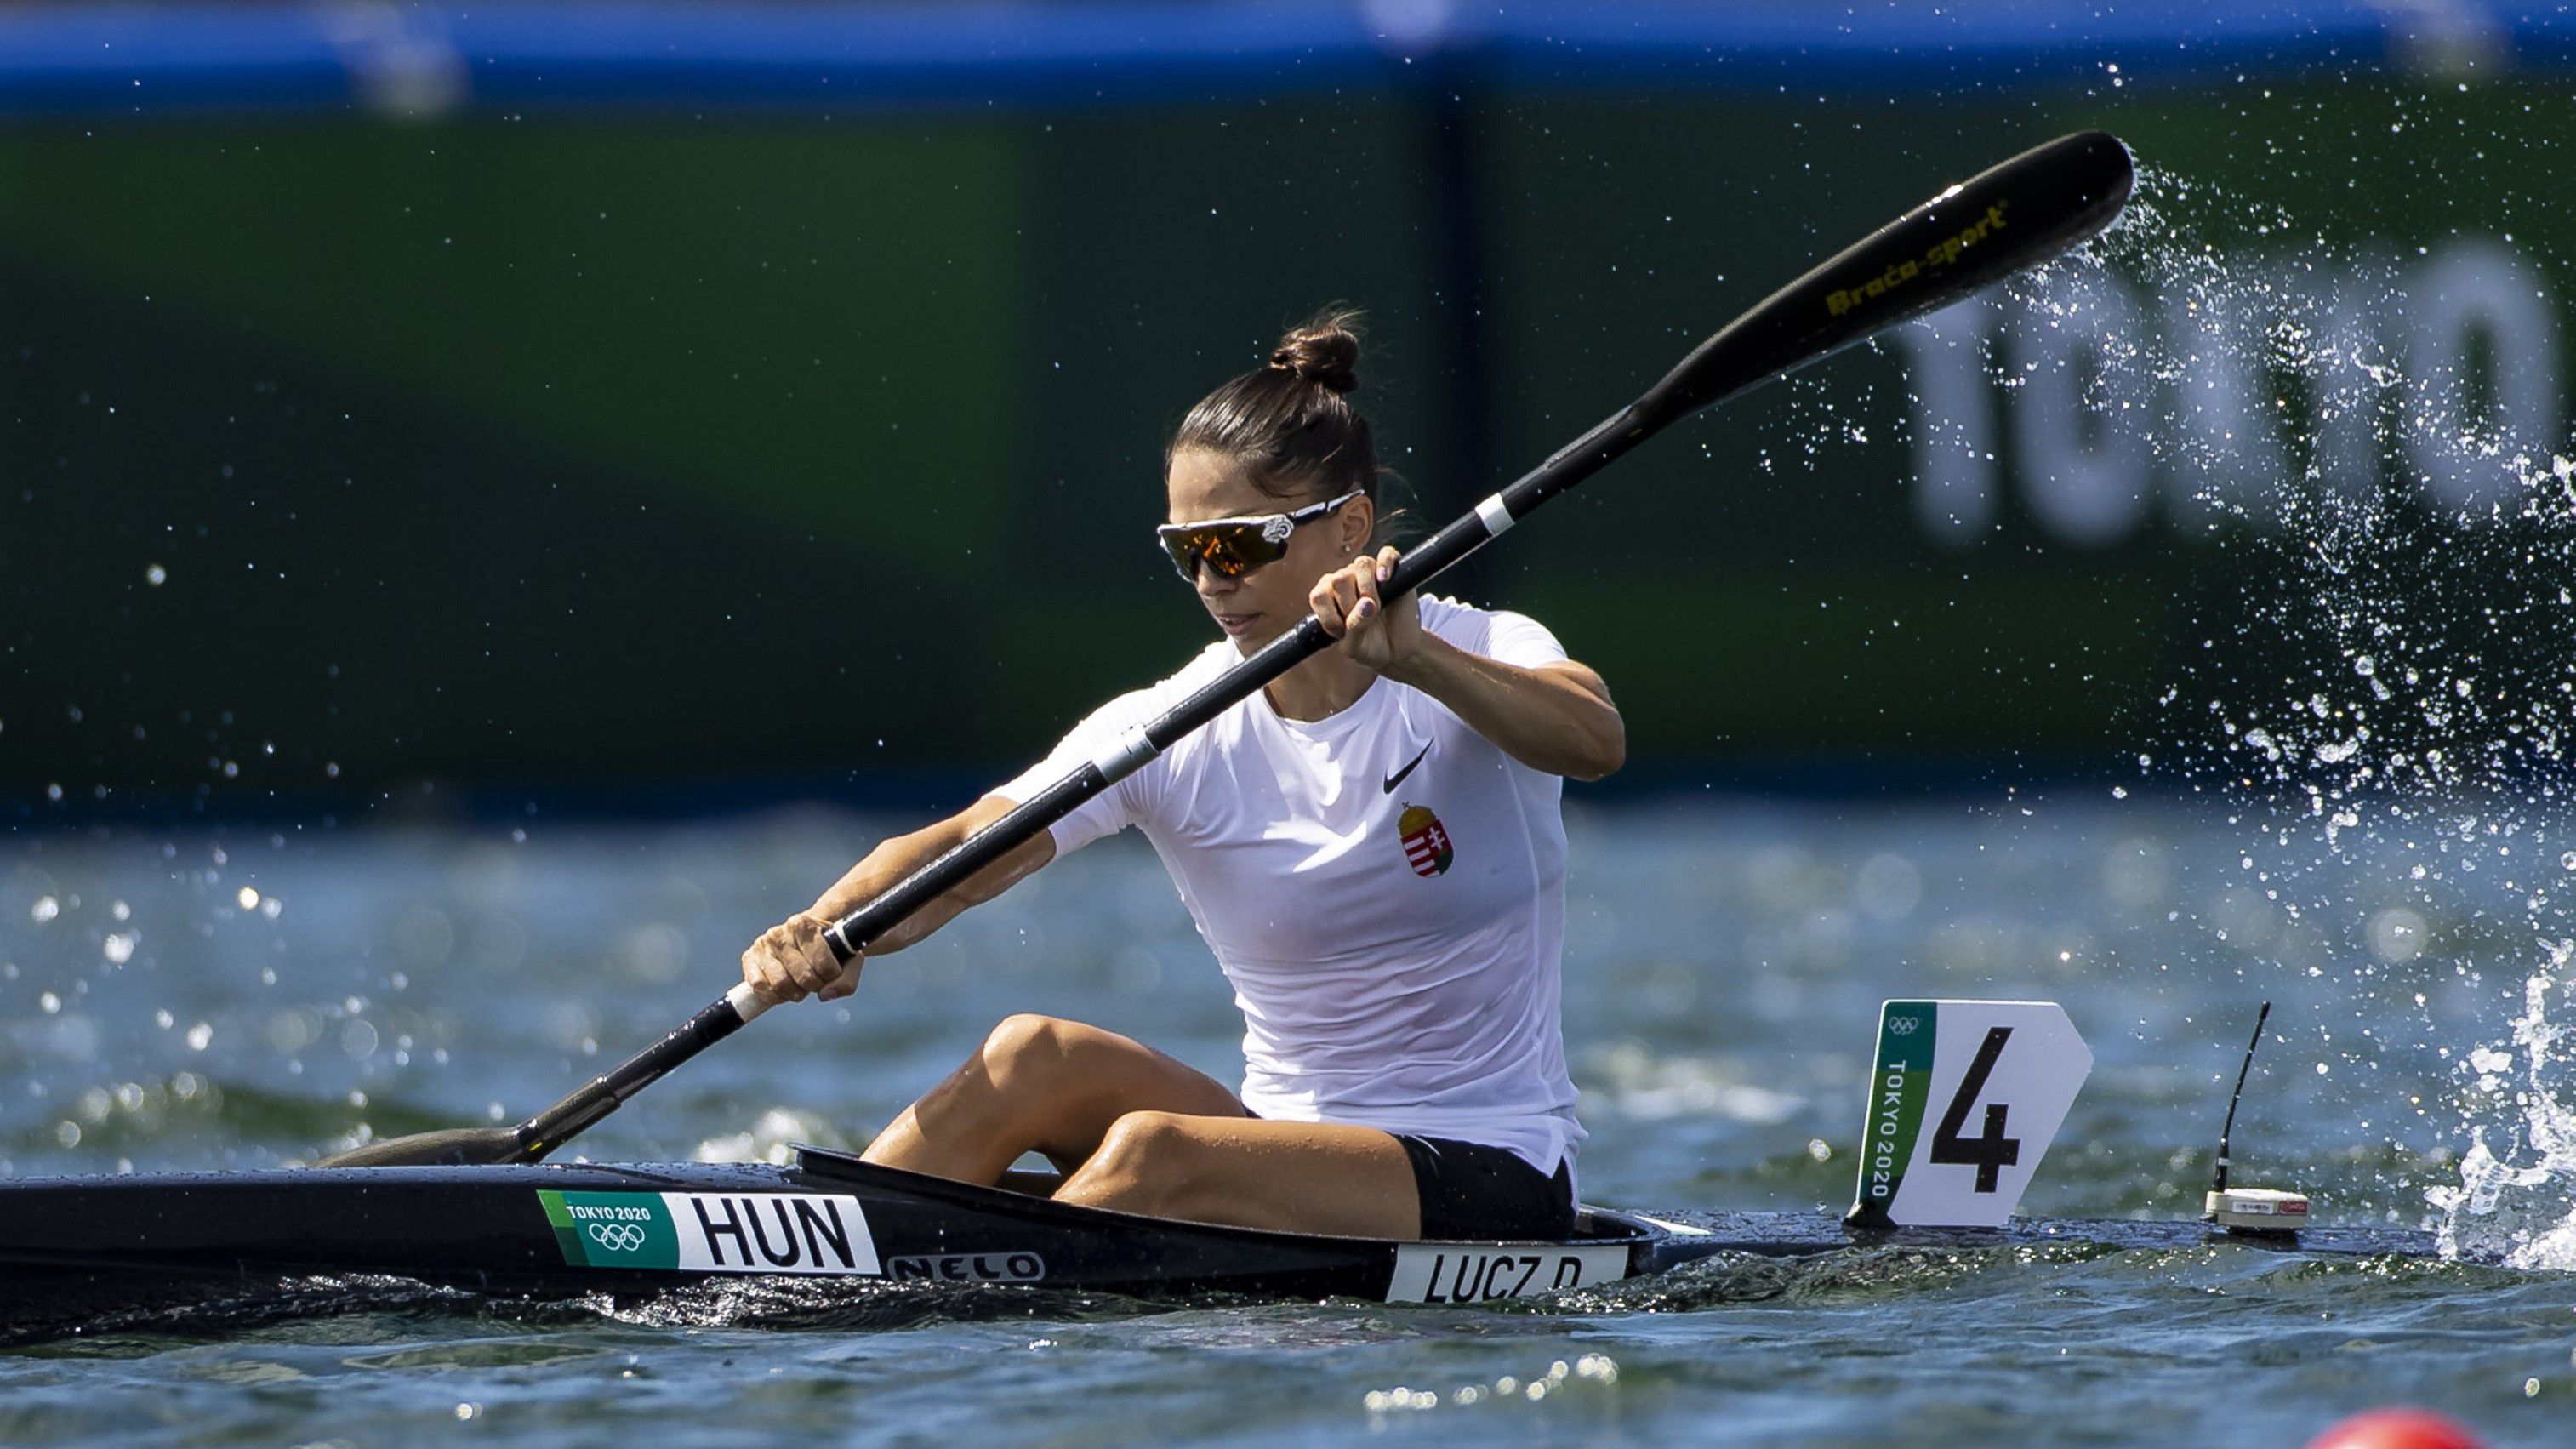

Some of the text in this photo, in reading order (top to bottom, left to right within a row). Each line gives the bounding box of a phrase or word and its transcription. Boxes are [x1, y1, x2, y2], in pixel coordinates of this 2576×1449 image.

[1872, 1060, 1906, 1197] TOKYO 2020
[1929, 1027, 2020, 1193] 4
[566, 1206, 651, 1220] TOKYO 2020
[691, 1198, 856, 1269] HUN
[893, 1254, 1040, 1281] NELO
[1424, 1254, 1542, 1303] LUCZ
